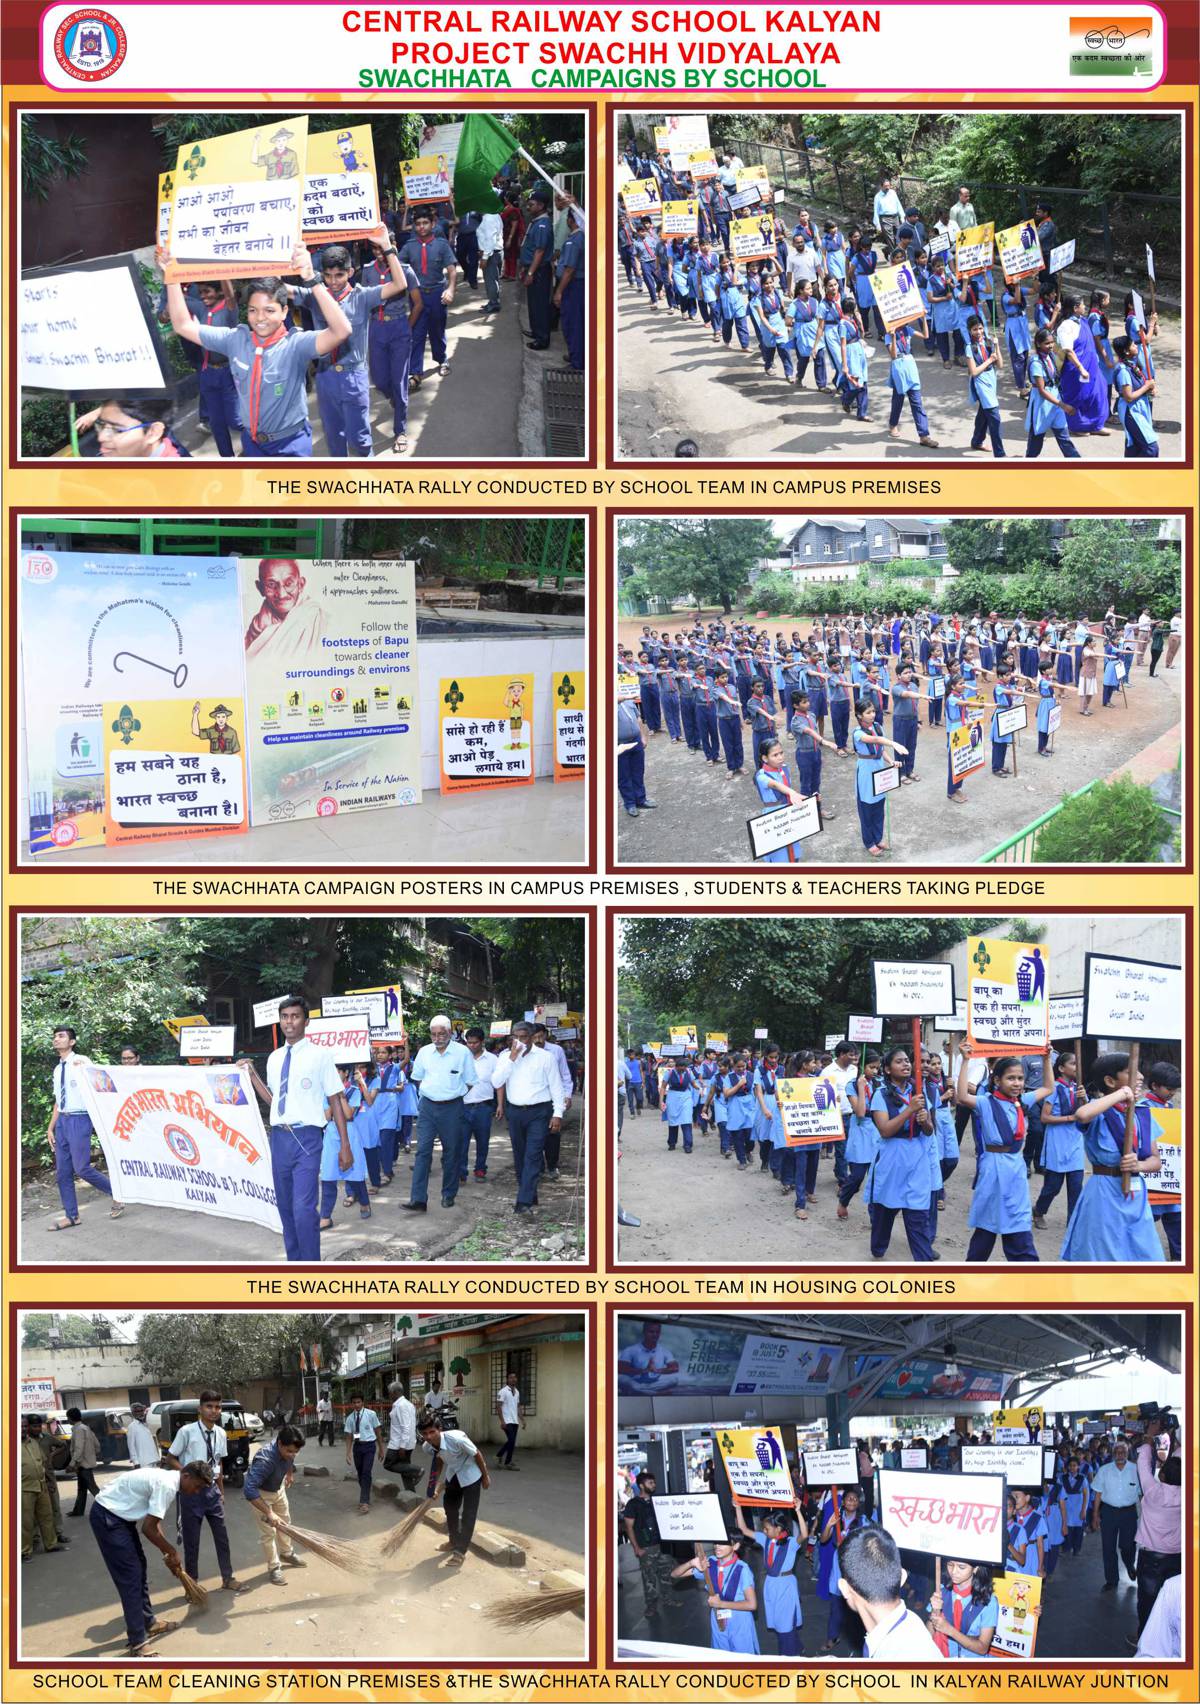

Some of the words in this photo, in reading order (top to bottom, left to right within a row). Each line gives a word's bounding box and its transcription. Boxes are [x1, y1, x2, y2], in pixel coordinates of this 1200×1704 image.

[308, 178, 327, 190] एक
[178, 191, 202, 208] आओ
[207, 185, 234, 203] आओ
[304, 191, 327, 201] कदम
[307, 203, 323, 215] को
[303, 215, 334, 226] स्वच्छ
[178, 225, 197, 239] सभी
[202, 226, 215, 238] का
[220, 220, 249, 235] जीवन
[213, 240, 240, 256] बेहतर
[245, 233, 274, 251] बनाये
[361, 623, 391, 632] Follow
[394, 622, 408, 631] the
[322, 637, 370, 648] footsteps
[372, 636, 382, 646] of
[384, 636, 409, 647] Bapu
[335, 652, 372, 661] towards
[374, 651, 410, 659] cleaner
[285, 667, 355, 678] surroundings
[358, 666, 366, 675] &
[368, 665, 410, 674] environs
[564, 712, 583, 723] साथी
[290, 733, 314, 741] maintain
[315, 731, 343, 739] cleanliness
[384, 726, 406, 734] premises
[446, 723, 465, 737] सांसे
[469, 722, 478, 735] हो
[481, 721, 495, 734] रही
[559, 727, 575, 736] हाथ
[577, 723, 584, 735] से
[465, 737, 488, 746] कम,
[448, 749, 476, 764] आओ
[480, 748, 495, 762] पेड़
[115, 760, 135, 774] हम
[141, 754, 175, 772] सबने
[179, 757, 200, 770] यह
[475, 760, 503, 774] लगाये
[507, 760, 525, 771] हम।
[176, 772, 206, 786] ठाना
[211, 766, 227, 785] है,
[323, 781, 332, 792] In
[335, 779, 359, 791] Service
[361, 777, 368, 788] of
[371, 777, 381, 785] the
[384, 775, 410, 783] Nation
[116, 793, 152, 807] भारत
[156, 790, 198, 805] स्वच्छ
[340, 797, 362, 806] INDIAN
[364, 794, 396, 804] RAILWAYS
[177, 806, 218, 819] बनाना
[223, 799, 238, 816] है।
[974, 986, 990, 998] बापू
[992, 986, 1003, 996] का
[974, 1003, 988, 1014] एक
[991, 1001, 999, 1012] ही
[1002, 1003, 1024, 1013] सपना,
[973, 1017, 997, 1026] स्वच्छ
[1000, 1016, 1014, 1026] और
[1017, 1015, 1031, 1028] सुंदर
[991, 1028, 1000, 1039] हो
[1002, 1029, 1021, 1037] भारत
[1023, 1029, 1046, 1038] अपना।
[170, 1090, 261, 1165] अभियान
[120, 1160, 153, 1178] CENTRAL
[153, 1162, 188, 1181] RAILWAY
[189, 1167, 221, 1189] SCHOOL
[185, 1188, 217, 1204] KALYAN
[687, 1363, 730, 1375] HOMES
